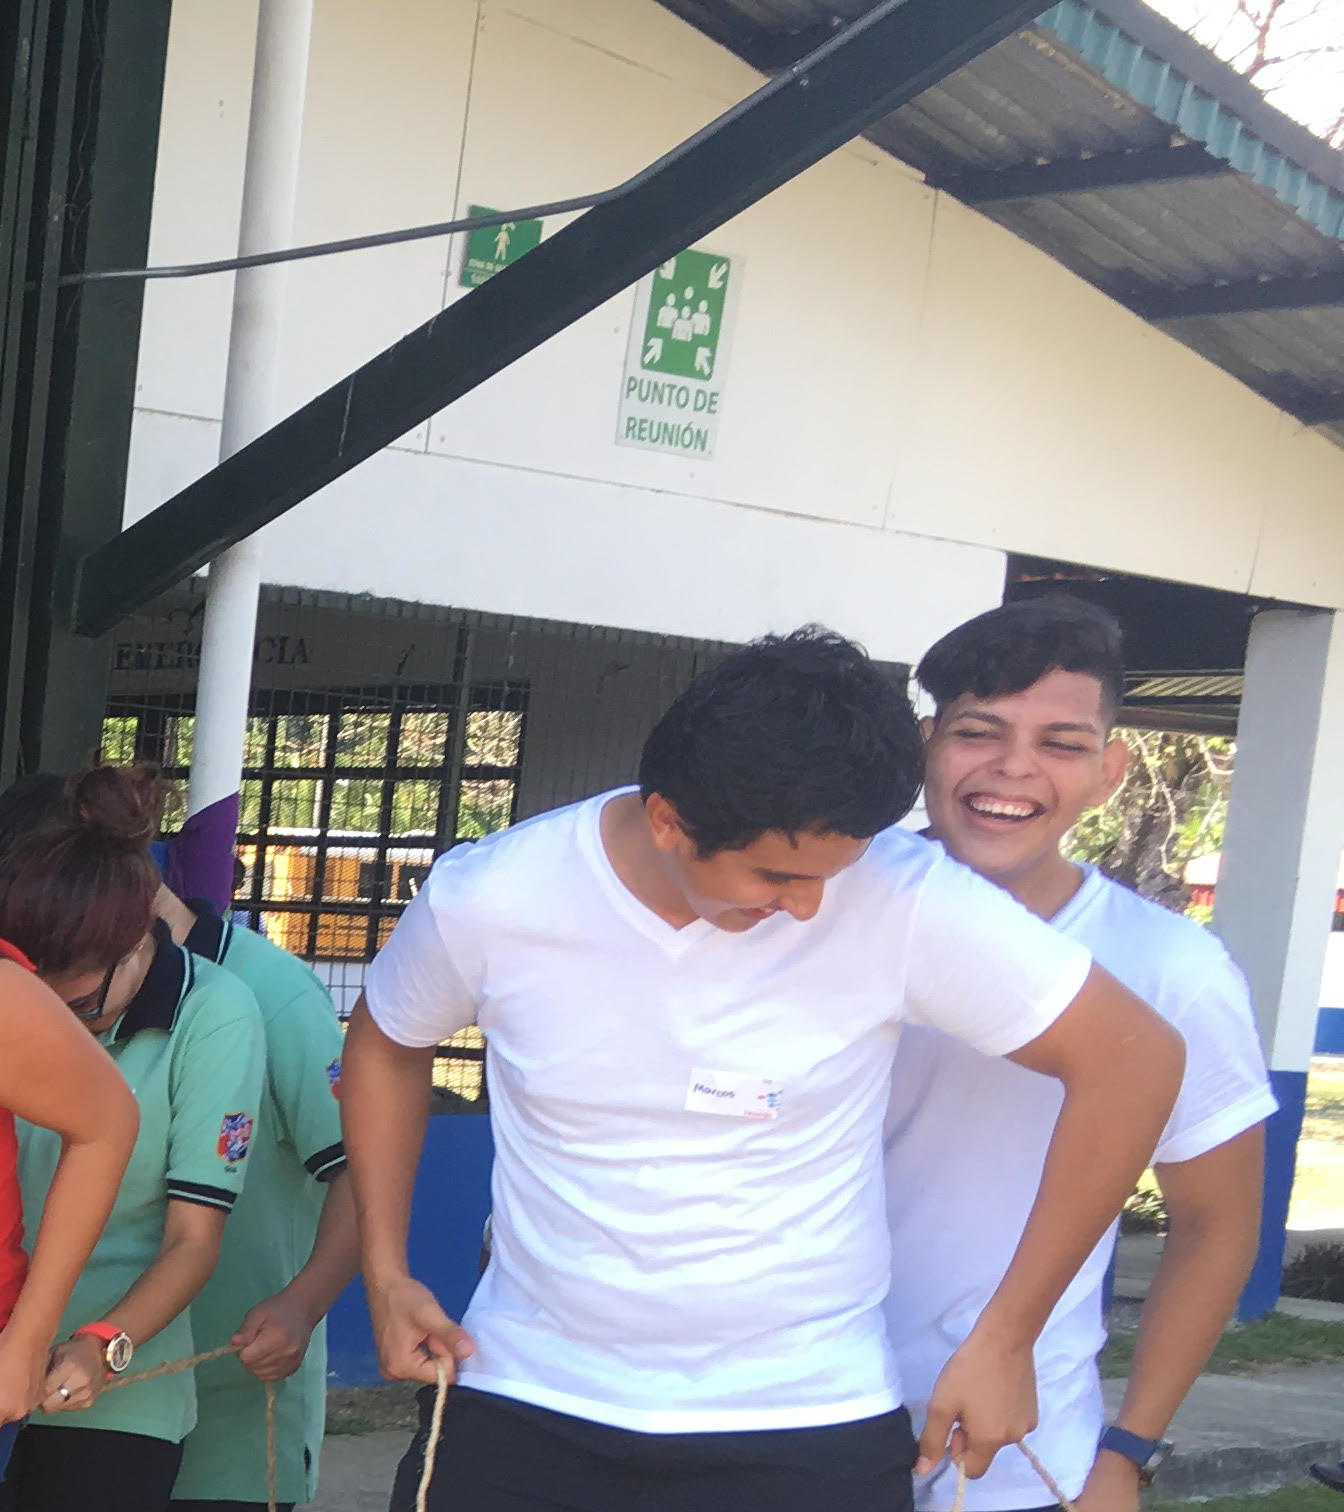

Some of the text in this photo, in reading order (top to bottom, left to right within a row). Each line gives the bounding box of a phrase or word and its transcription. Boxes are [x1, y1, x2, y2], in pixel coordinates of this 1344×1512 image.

[625, 376, 720, 414] PUNTO DE
[624, 416, 709, 452] REUNIÓN
